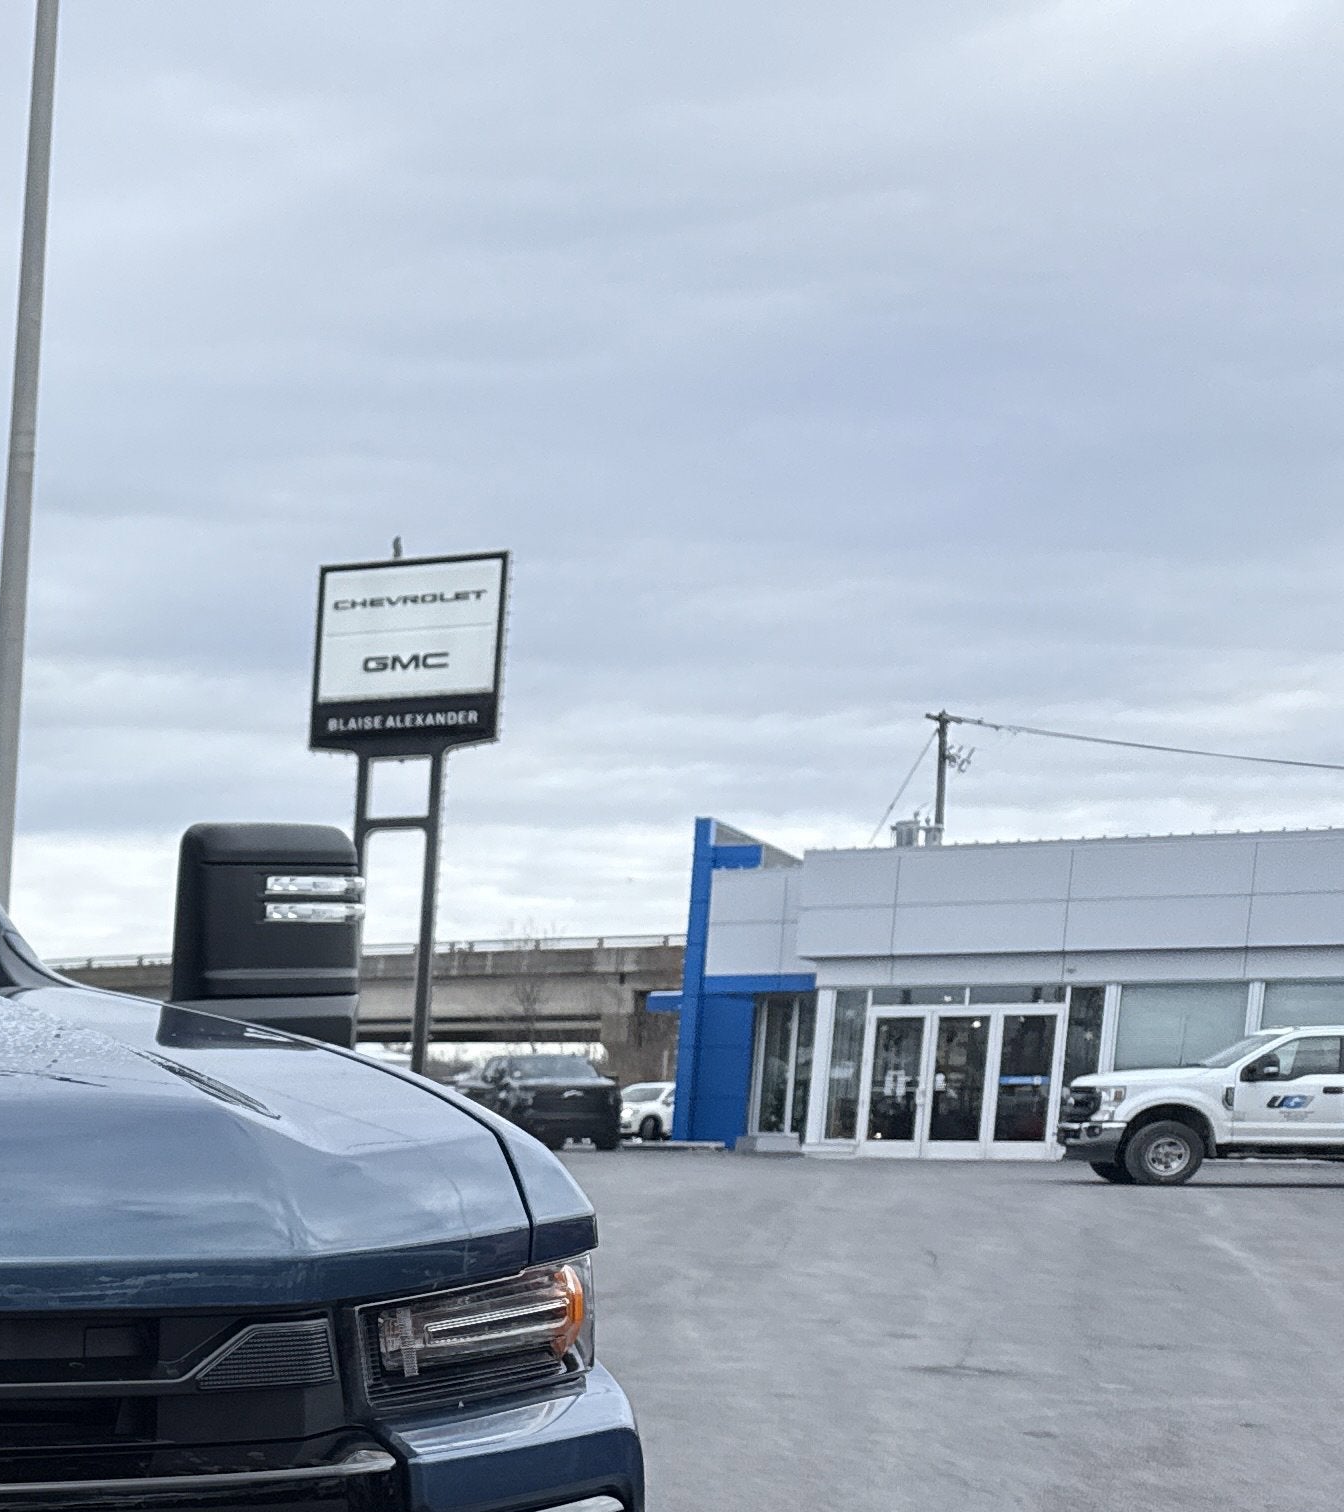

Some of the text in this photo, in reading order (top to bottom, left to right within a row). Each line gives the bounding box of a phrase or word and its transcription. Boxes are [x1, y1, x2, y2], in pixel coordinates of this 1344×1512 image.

[333, 590, 486, 610] CHEVROLET
[363, 652, 449, 673] GMC
[327, 710, 478, 732] BLAISE ALEXANDER
